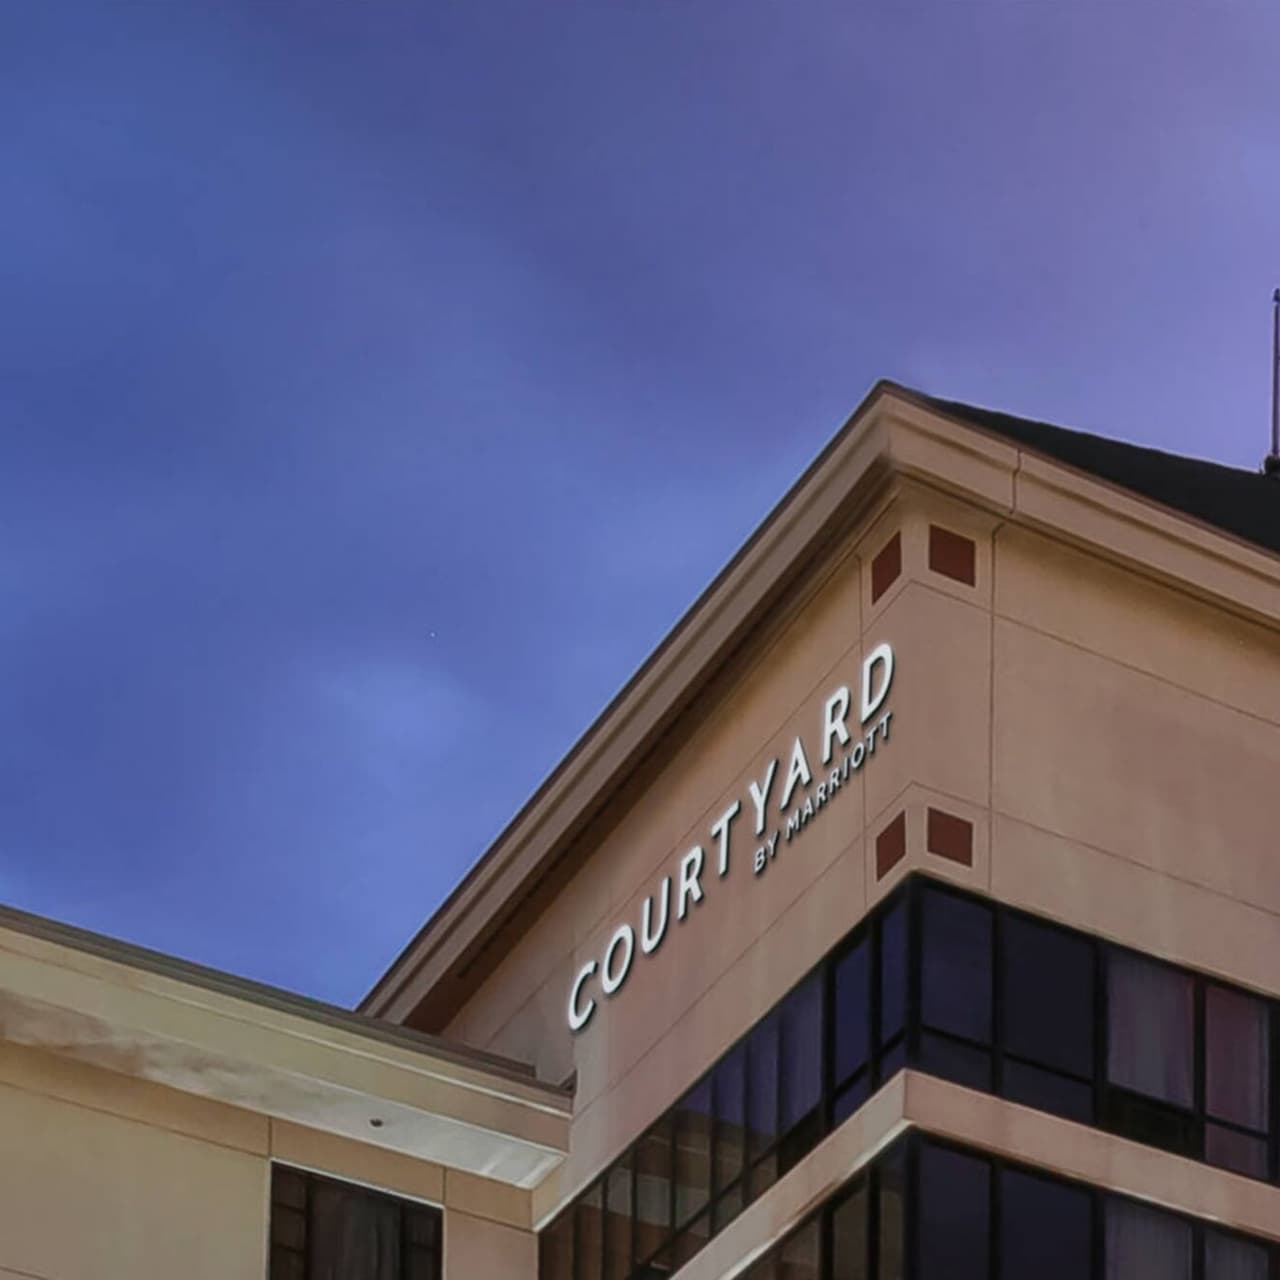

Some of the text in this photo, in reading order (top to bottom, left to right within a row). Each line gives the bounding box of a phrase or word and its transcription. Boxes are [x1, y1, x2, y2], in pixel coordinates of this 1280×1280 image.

[567, 643, 895, 1031] COURTYARD
[753, 711, 893, 874] BY MARRIOTT
